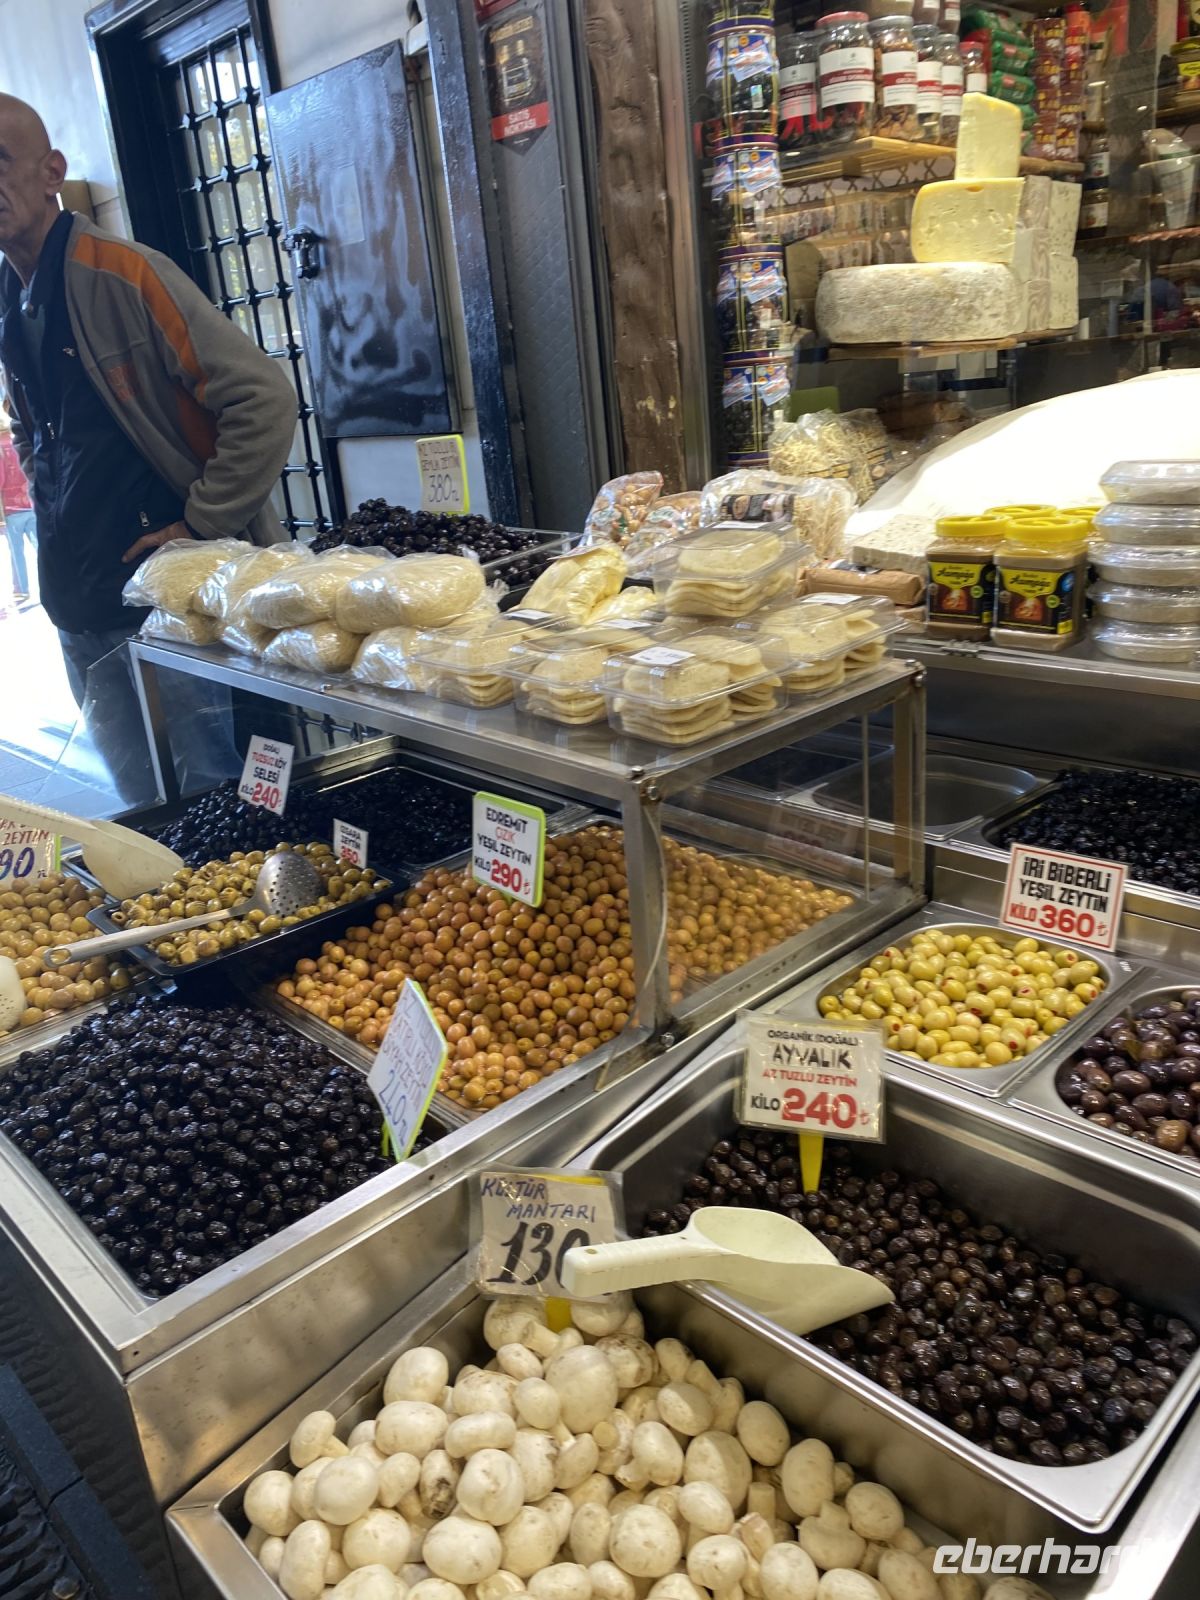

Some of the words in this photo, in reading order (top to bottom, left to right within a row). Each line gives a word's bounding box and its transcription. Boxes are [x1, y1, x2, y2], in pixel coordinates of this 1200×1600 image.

[1022, 856, 1044, 878] İRİ
[1048, 862, 1112, 893] BİBERLİ
[1019, 878, 1055, 901] YEŞİL
[1059, 887, 1108, 913] ZEYTİN
[767, 1029, 812, 1042] ORGANİK
[772, 1043, 853, 1069] AYVALIK
[780, 1070, 814, 1083] TUZLU
[817, 1073, 857, 1087] ZEYTİN
[750, 1092, 780, 1111] KİLO
[506, 1202, 596, 1223] MANTARI
